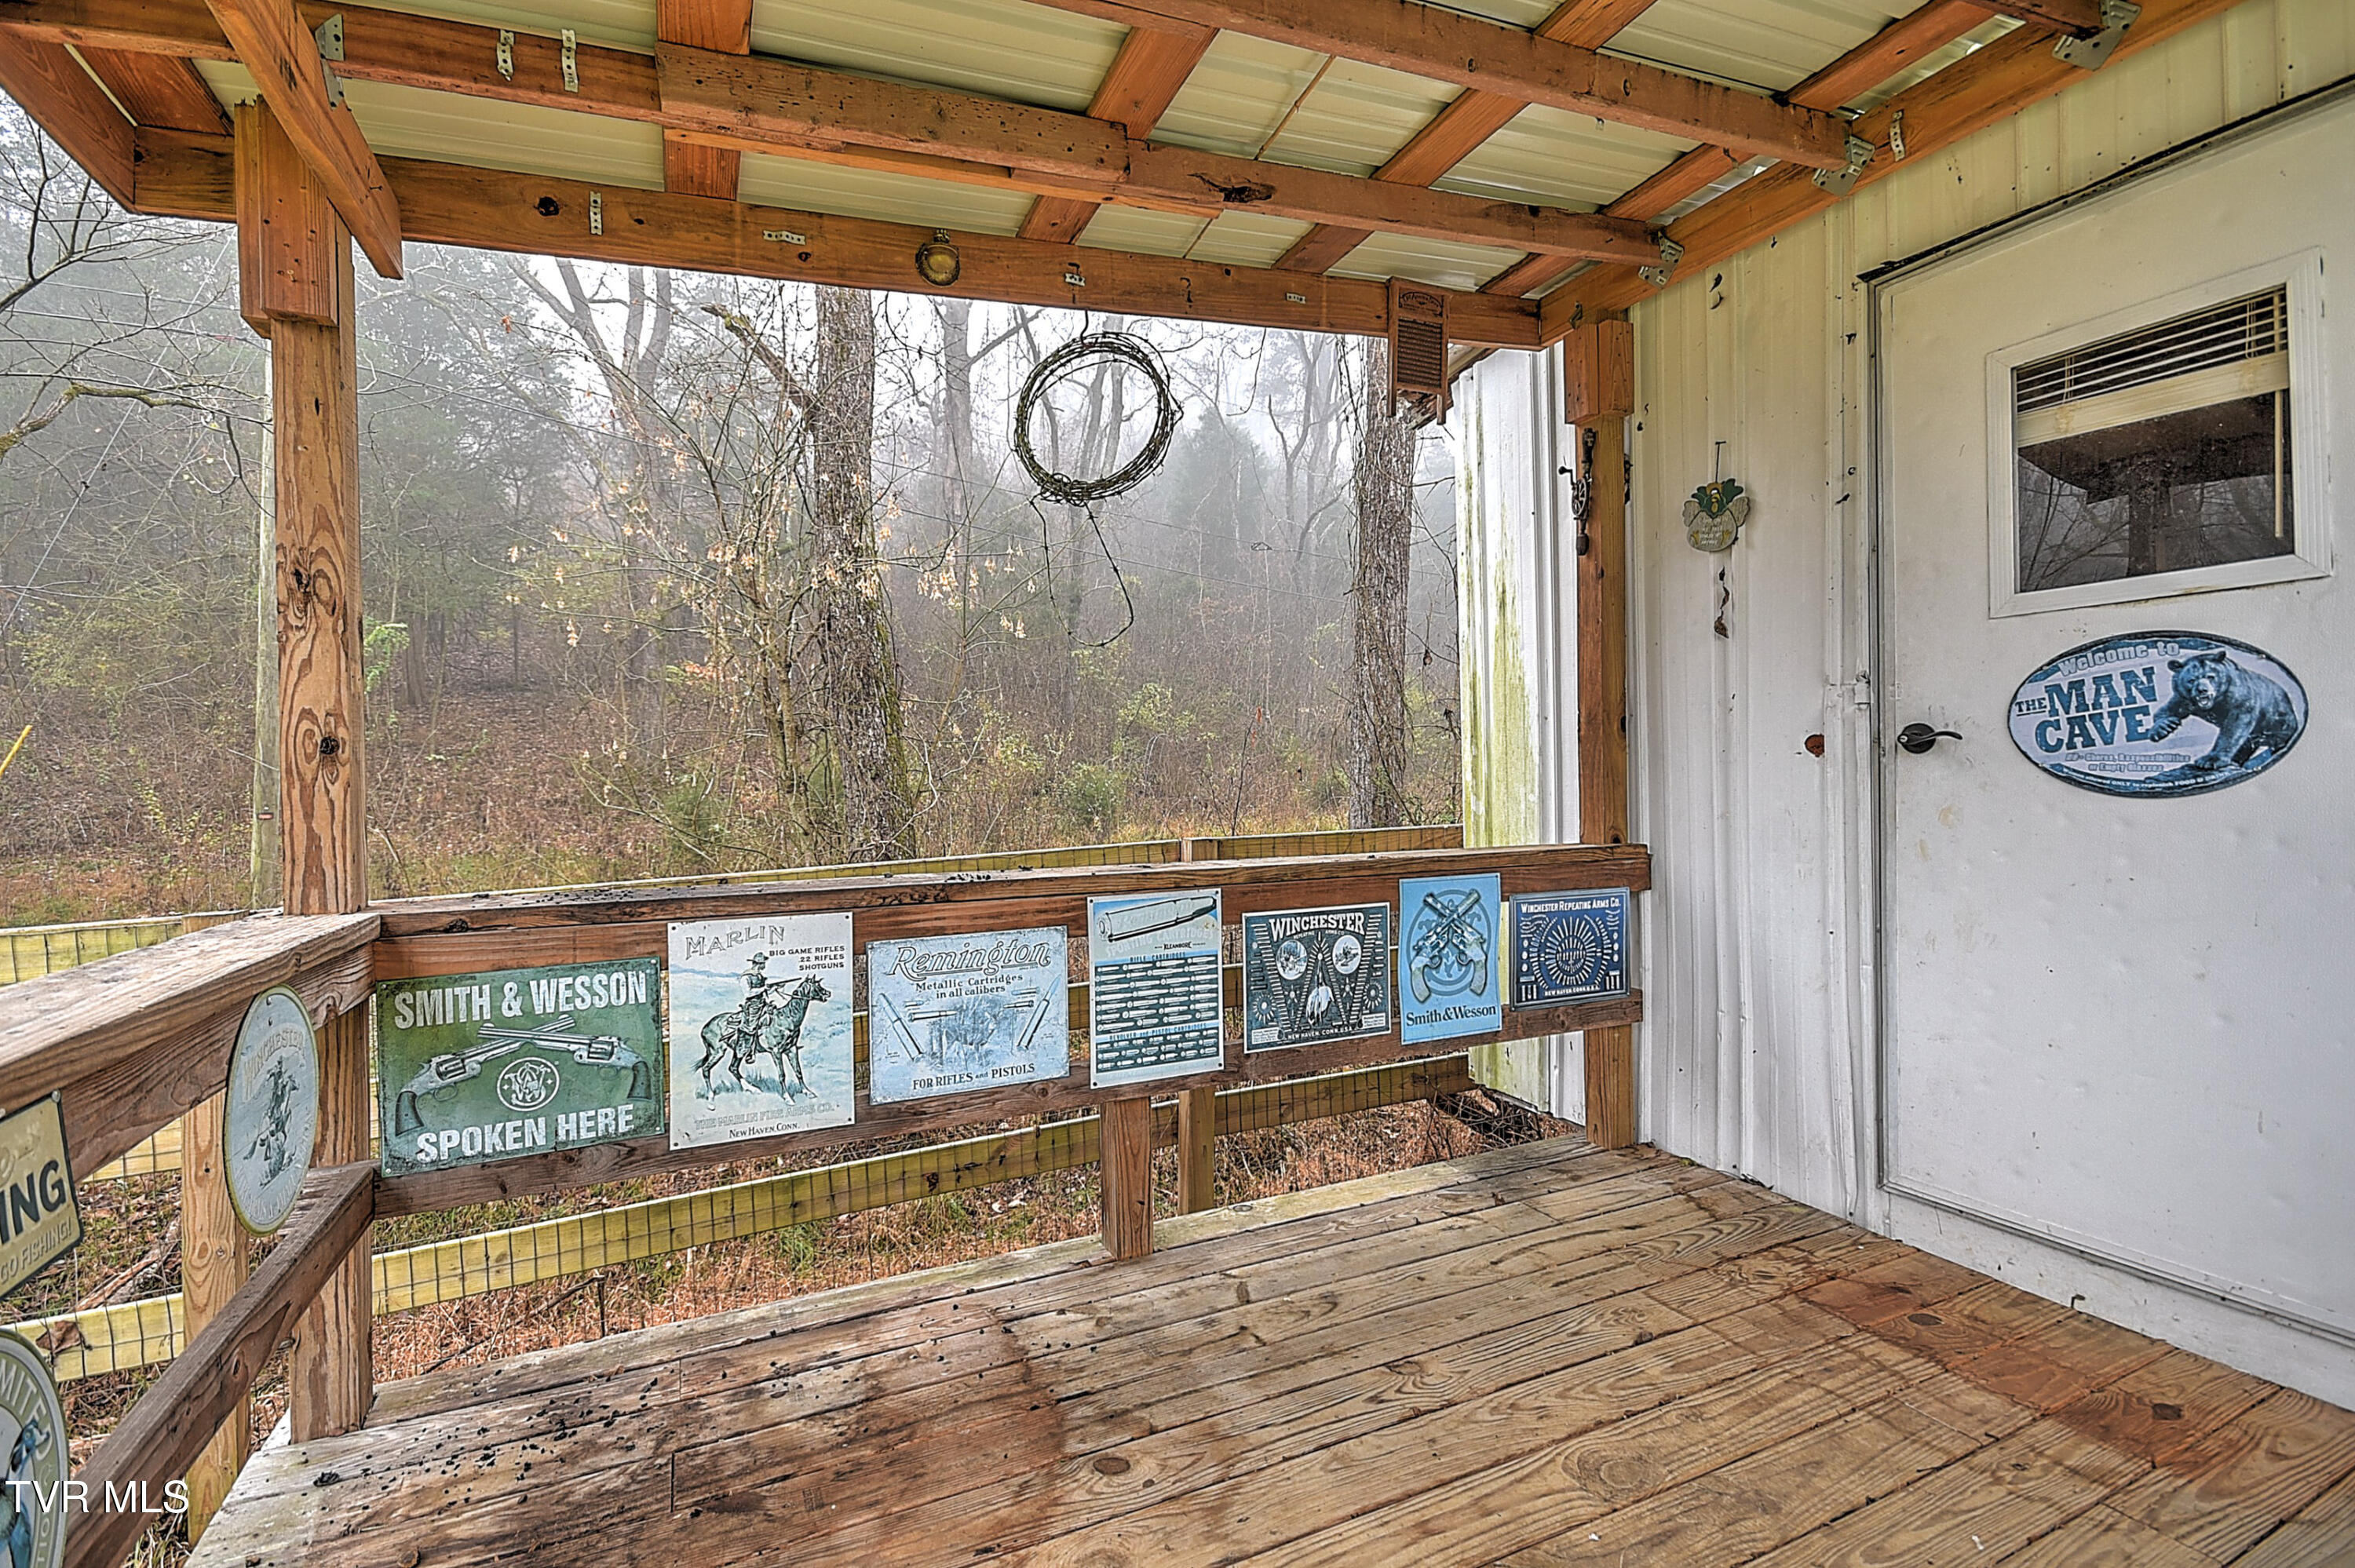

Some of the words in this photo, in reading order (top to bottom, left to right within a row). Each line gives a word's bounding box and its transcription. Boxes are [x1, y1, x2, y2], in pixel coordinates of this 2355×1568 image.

[2058, 644, 2149, 676] Welcome
[2157, 641, 2180, 656] to
[2015, 697, 2047, 713] THE
[2044, 666, 2157, 718] MAN
[2035, 705, 2151, 753] CAVE
[1521, 903, 1558, 913] WINCHESTER
[1559, 901, 1591, 910] REPEATING
[1592, 899, 1609, 909] ARMS
[685, 924, 785, 961] MARLIN
[1105, 933, 1152, 957] SPORTING
[1157, 927, 1214, 942] CARTRIDGES
[1269, 912, 1366, 943] WINCHESTER
[799, 962, 845, 972] SHOTGUNS
[814, 954, 845, 962] RIFLES
[885, 939, 1051, 982] Remington
[1152, 951, 1186, 961] CARTRIDGES
[915, 979, 963, 992] Metallic
[968, 974, 1023, 986] Cartridges
[936, 990, 947, 999] in
[948, 988, 962, 997] all
[965, 985, 1006, 996] calibers
[395, 984, 491, 1030] SMITH
[501, 981, 523, 1018] &
[529, 971, 648, 1016] WESSON
[912, 1078, 933, 1090] FOR
[936, 1072, 973, 1087] RIFLES
[991, 1063, 1035, 1079] PISTOLS
[417, 1117, 546, 1164] SPOKEN
[556, 1103, 636, 1142] HERE
[695, 1117, 716, 1131] THE
[717, 1112, 758, 1127] MARLIN
[759, 1108, 783, 1121] FIRE
[1, 1256, 19, 1285] GO
[22, 1216, 72, 1271] FISHING!
